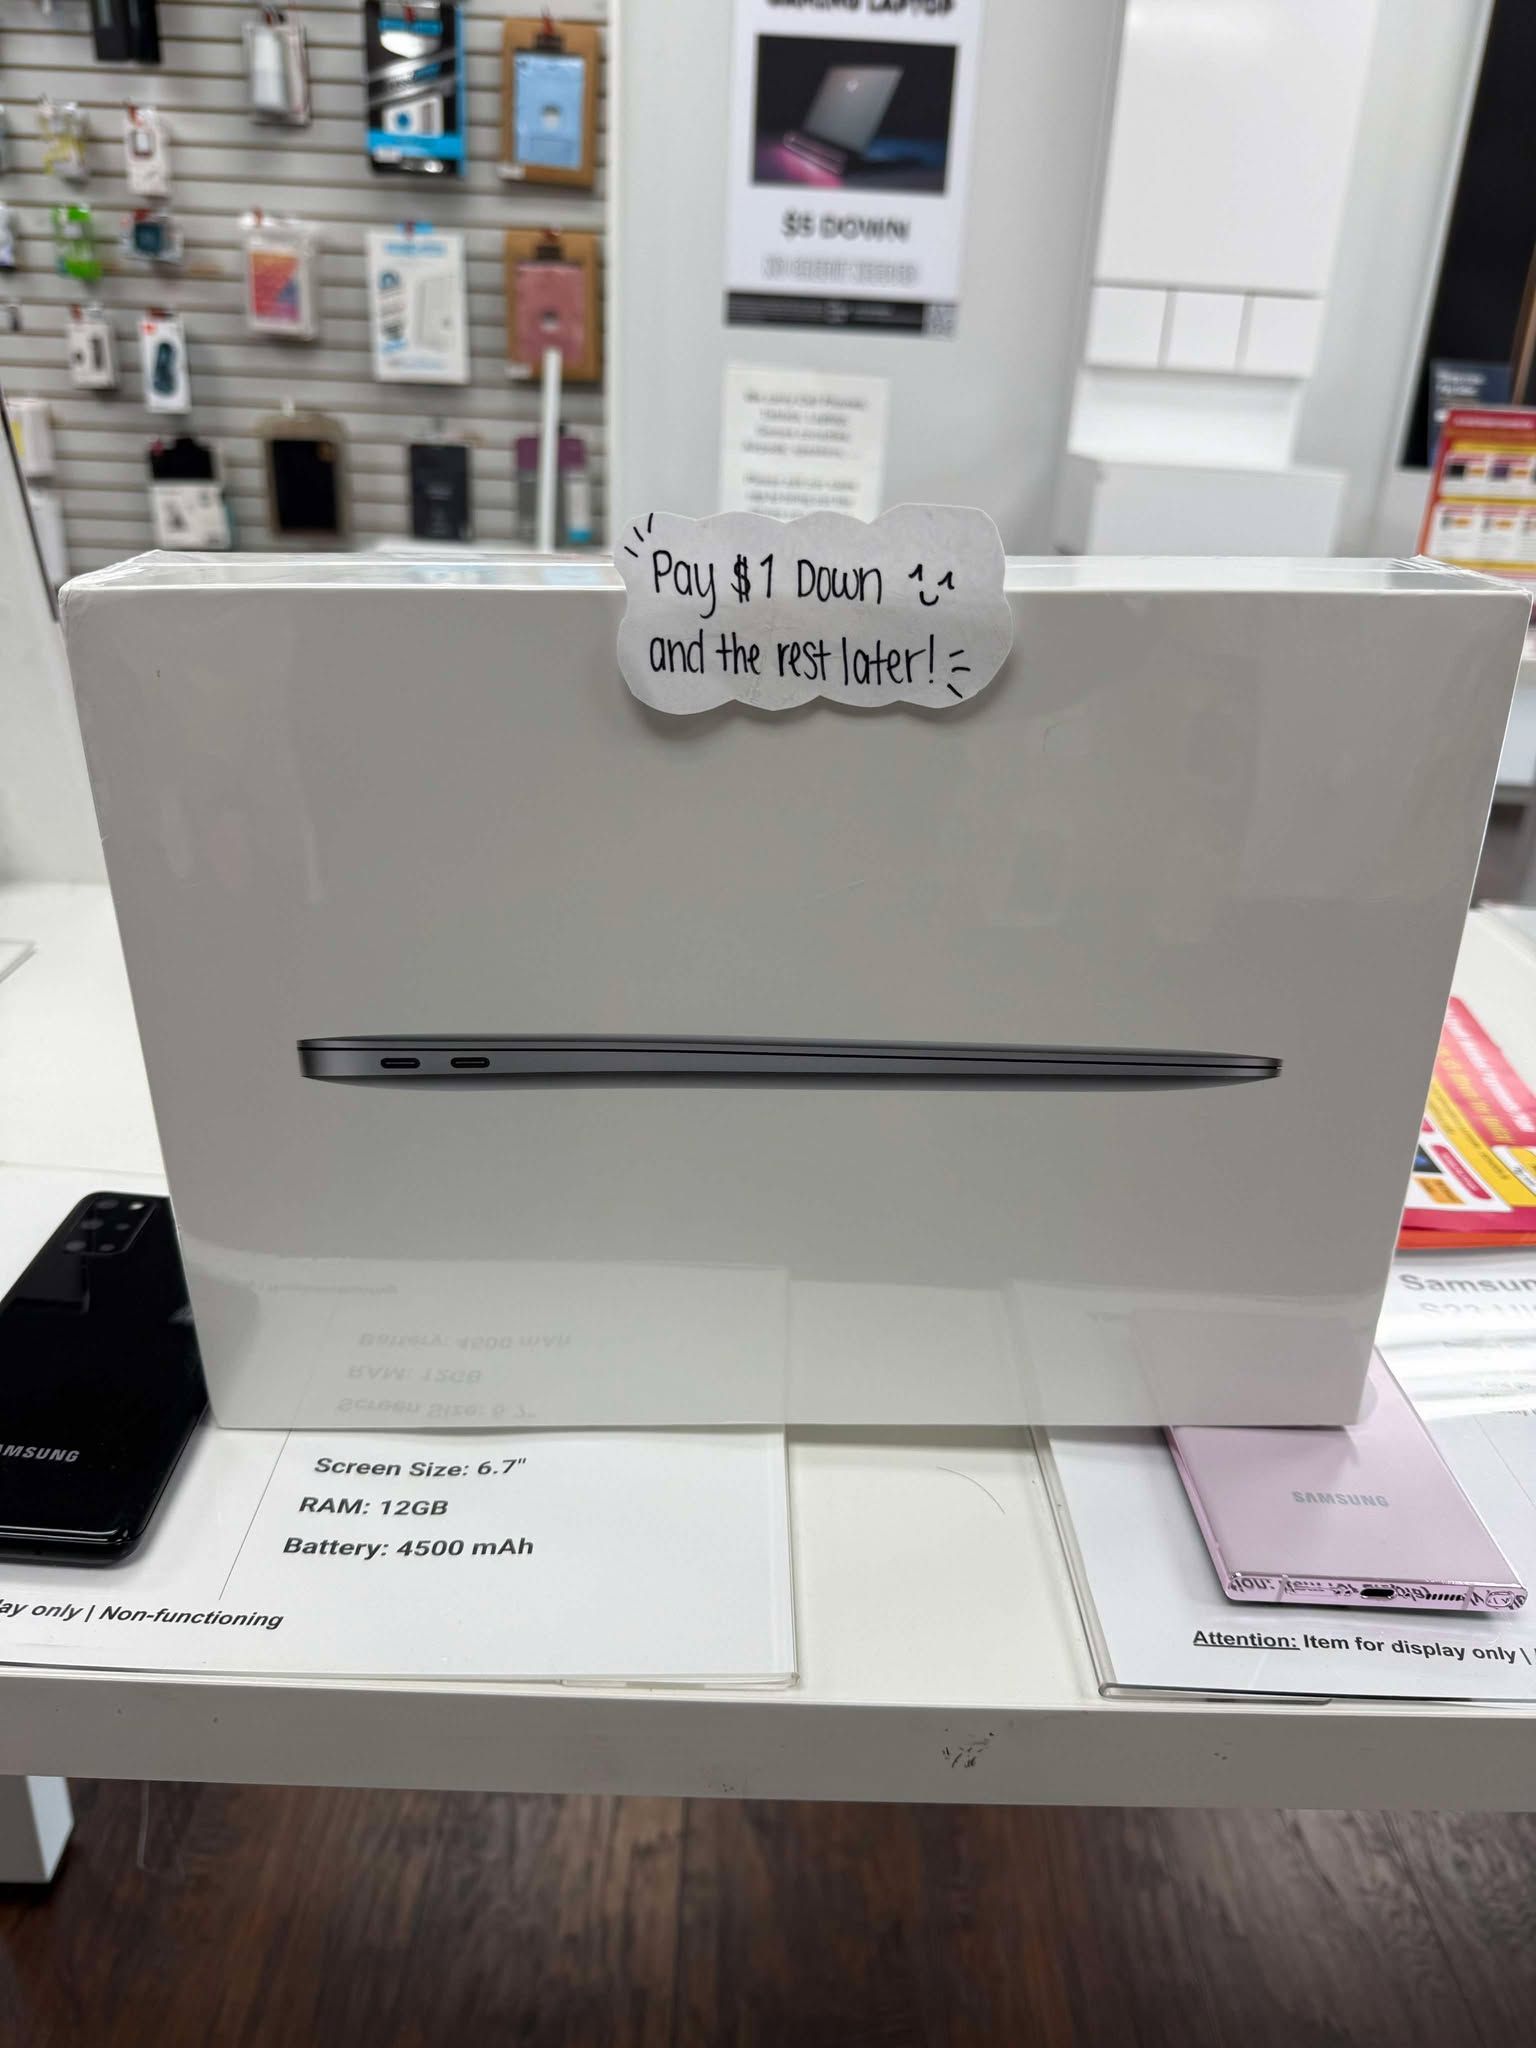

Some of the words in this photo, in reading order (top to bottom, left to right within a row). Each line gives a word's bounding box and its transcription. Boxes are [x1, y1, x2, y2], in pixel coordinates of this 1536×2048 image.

[820, 214, 911, 242] DOWN
[653, 550, 716, 619] Pay
[731, 553, 773, 603] $1
[797, 559, 882, 605] Down
[650, 629, 704, 674] and
[716, 632, 760, 675] the
[777, 640, 831, 681] rest
[842, 634, 934, 686] later!
[1398, 1273, 1536, 1292] Samsun
[0, 1443, 80, 1463] MSUNG
[314, 1457, 402, 1477] Screen
[409, 1461, 470, 1478] Size:
[476, 1457, 527, 1476] 6.7"
[299, 1496, 371, 1515] RAM:
[380, 1499, 449, 1516] 12GB
[1291, 1490, 1389, 1508] SAMSUNG
[282, 1537, 389, 1560] Battery:
[396, 1539, 465, 1557] 4500
[471, 1537, 534, 1556] mAh
[0, 1599, 29, 1618] ay
[31, 1603, 84, 1621] only
[98, 1605, 285, 1630] Non-functioning
[1193, 1630, 1299, 1650] Attention:
[1303, 1634, 1349, 1650] Item
[1355, 1636, 1385, 1652] for
[1392, 1639, 1465, 1661] display
[1472, 1646, 1516, 1664] only
